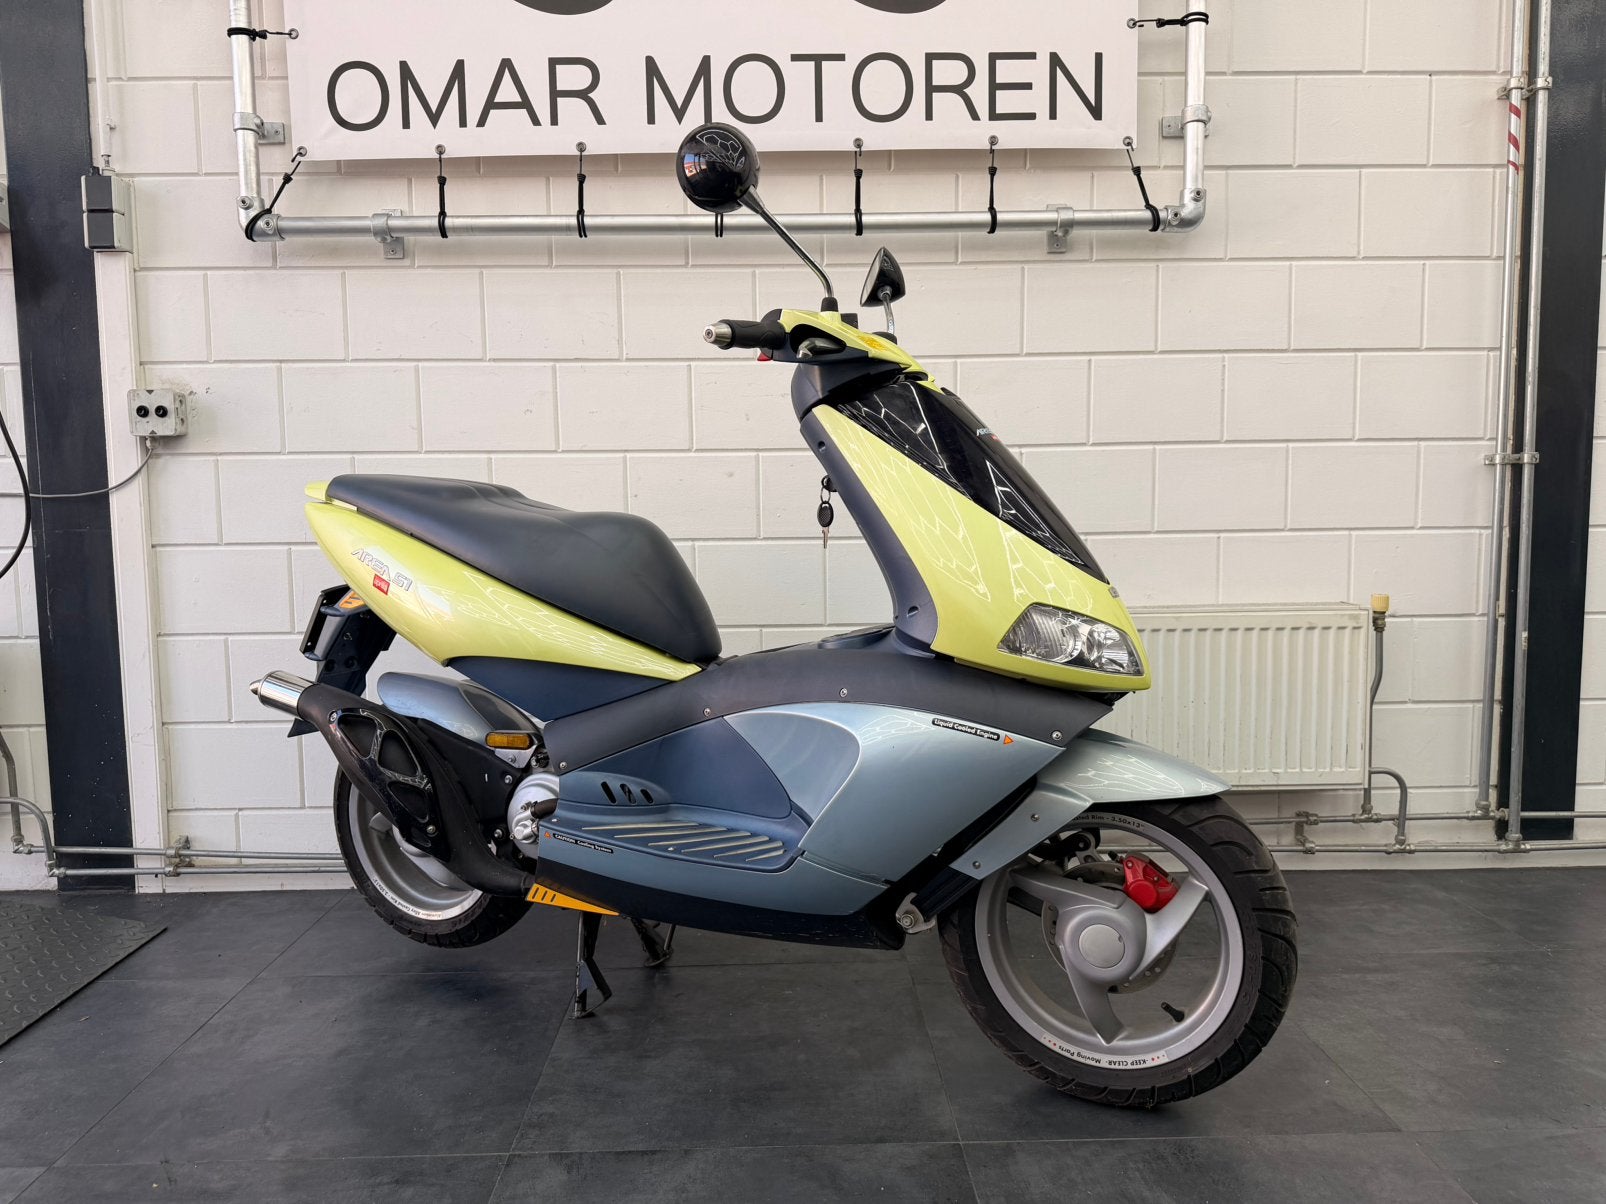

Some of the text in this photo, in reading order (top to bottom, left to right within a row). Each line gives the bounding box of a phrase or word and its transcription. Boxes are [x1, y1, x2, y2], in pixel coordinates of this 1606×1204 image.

[327, 52, 1103, 131] OMAR MOTOREN
[351, 548, 391, 582] AREA
[934, 718, 998, 740] Liquid Cooled Engine
[577, 840, 595, 849] Cooling
[595, 845, 612, 853] System
[1058, 1045, 1075, 1057] Parts
[1076, 1050, 1102, 1064] Moving
